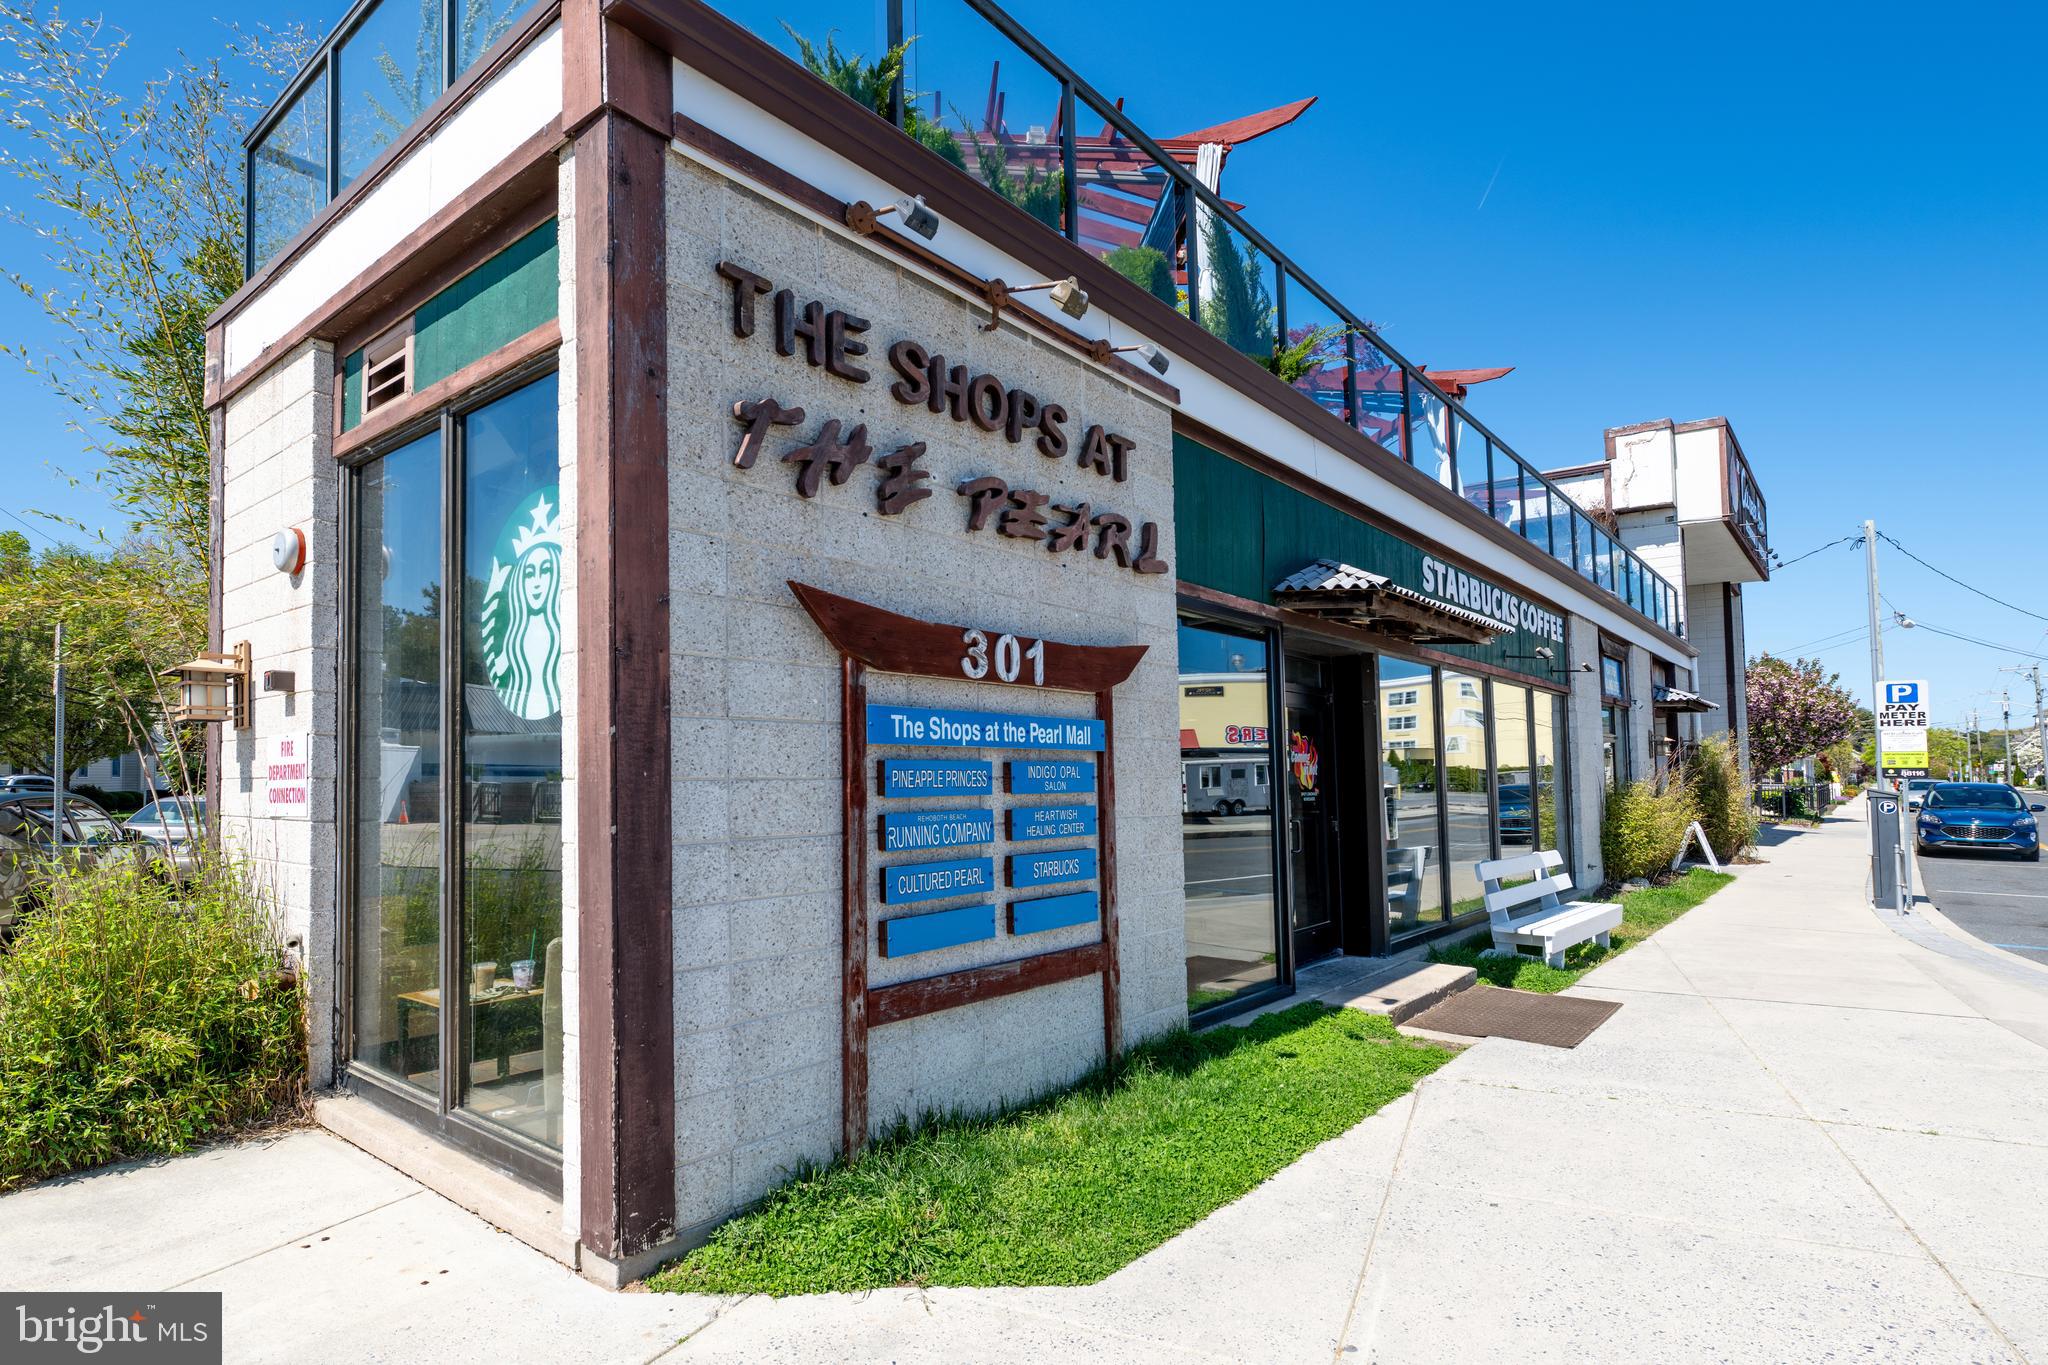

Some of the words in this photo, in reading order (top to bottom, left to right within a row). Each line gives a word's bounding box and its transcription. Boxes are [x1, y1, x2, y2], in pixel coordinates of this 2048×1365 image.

[715, 261, 872, 383] THE
[889, 340, 1068, 458] SHOPS
[1078, 425, 1137, 482] AT
[732, 399, 933, 516] THE
[957, 477, 1169, 574] PEARL
[1422, 556, 1519, 627] STARBUCKS
[1519, 602, 1564, 643] COFFEE
[961, 629, 1045, 687] 301
[1879, 711, 1927, 719] METER
[1885, 703, 1920, 712] PAY
[891, 714, 924, 739] The
[929, 716, 981, 745] Shops
[985, 722, 999, 742] at
[1003, 724, 1026, 742] the
[1030, 723, 1062, 744] Pearl
[1066, 726, 1091, 745] Mall
[1880, 719, 1927, 727] HERE
[281, 741, 294, 757] FIRE
[268, 763, 306, 781] DEPARTMENT
[892, 770, 944, 788] PINEAPPLE
[946, 771, 988, 788] PRINCESS
[1027, 766, 1057, 779] INDIGO
[1060, 766, 1081, 779] OPAL
[1044, 781, 1067, 791] SALON
[269, 787, 306, 804] CONNECTION
[917, 814, 948, 822] REHOBOTH
[1034, 809, 1078, 821] HEARTWISH
[888, 825, 940, 849] RUNNING
[942, 821, 992, 845] COMPANY
[1026, 824, 1056, 837] HEALING
[1059, 822, 1085, 834] CENTER
[1033, 858, 1080, 879] STARBUCKS
[898, 871, 952, 894] CULTURED
[954, 868, 985, 887] PEARL
